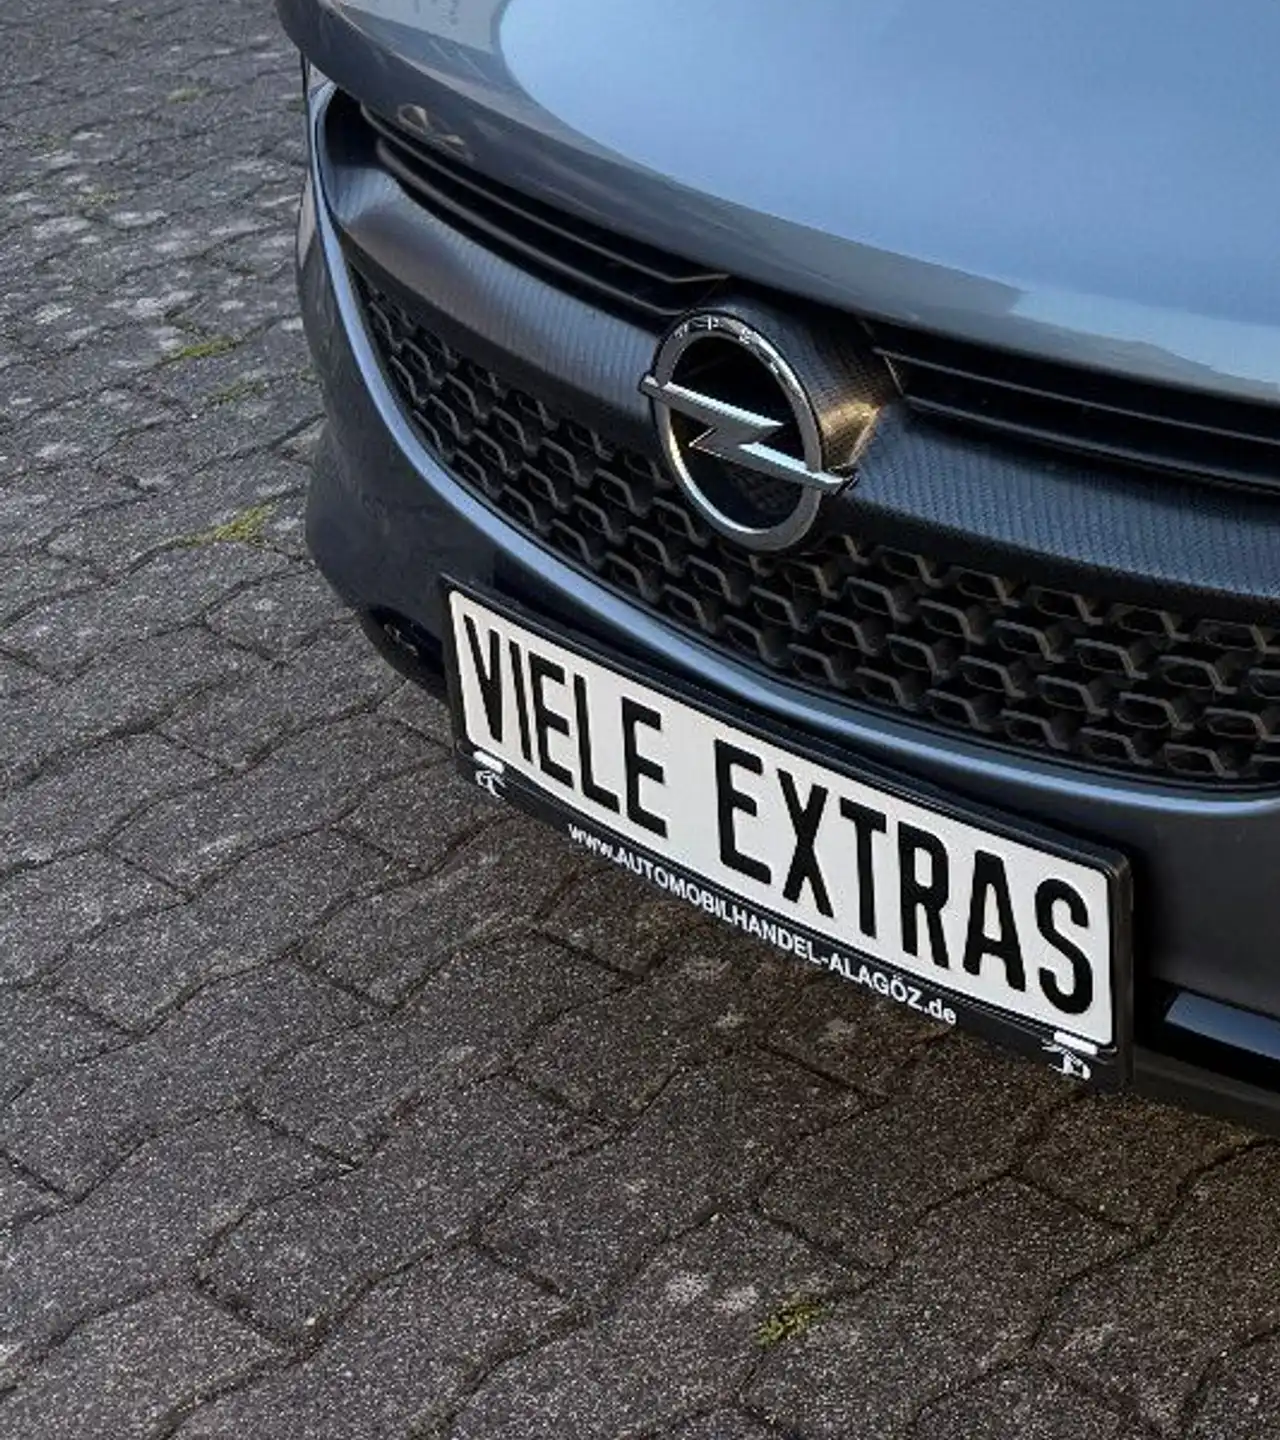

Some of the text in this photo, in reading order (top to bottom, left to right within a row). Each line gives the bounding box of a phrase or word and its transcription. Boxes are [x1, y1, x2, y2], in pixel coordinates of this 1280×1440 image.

[464, 614, 1094, 1015] VIELE EXTRAS
[568, 823, 959, 1026] www.AUTOMOBILHANDEL-ALAGÖZ.de
